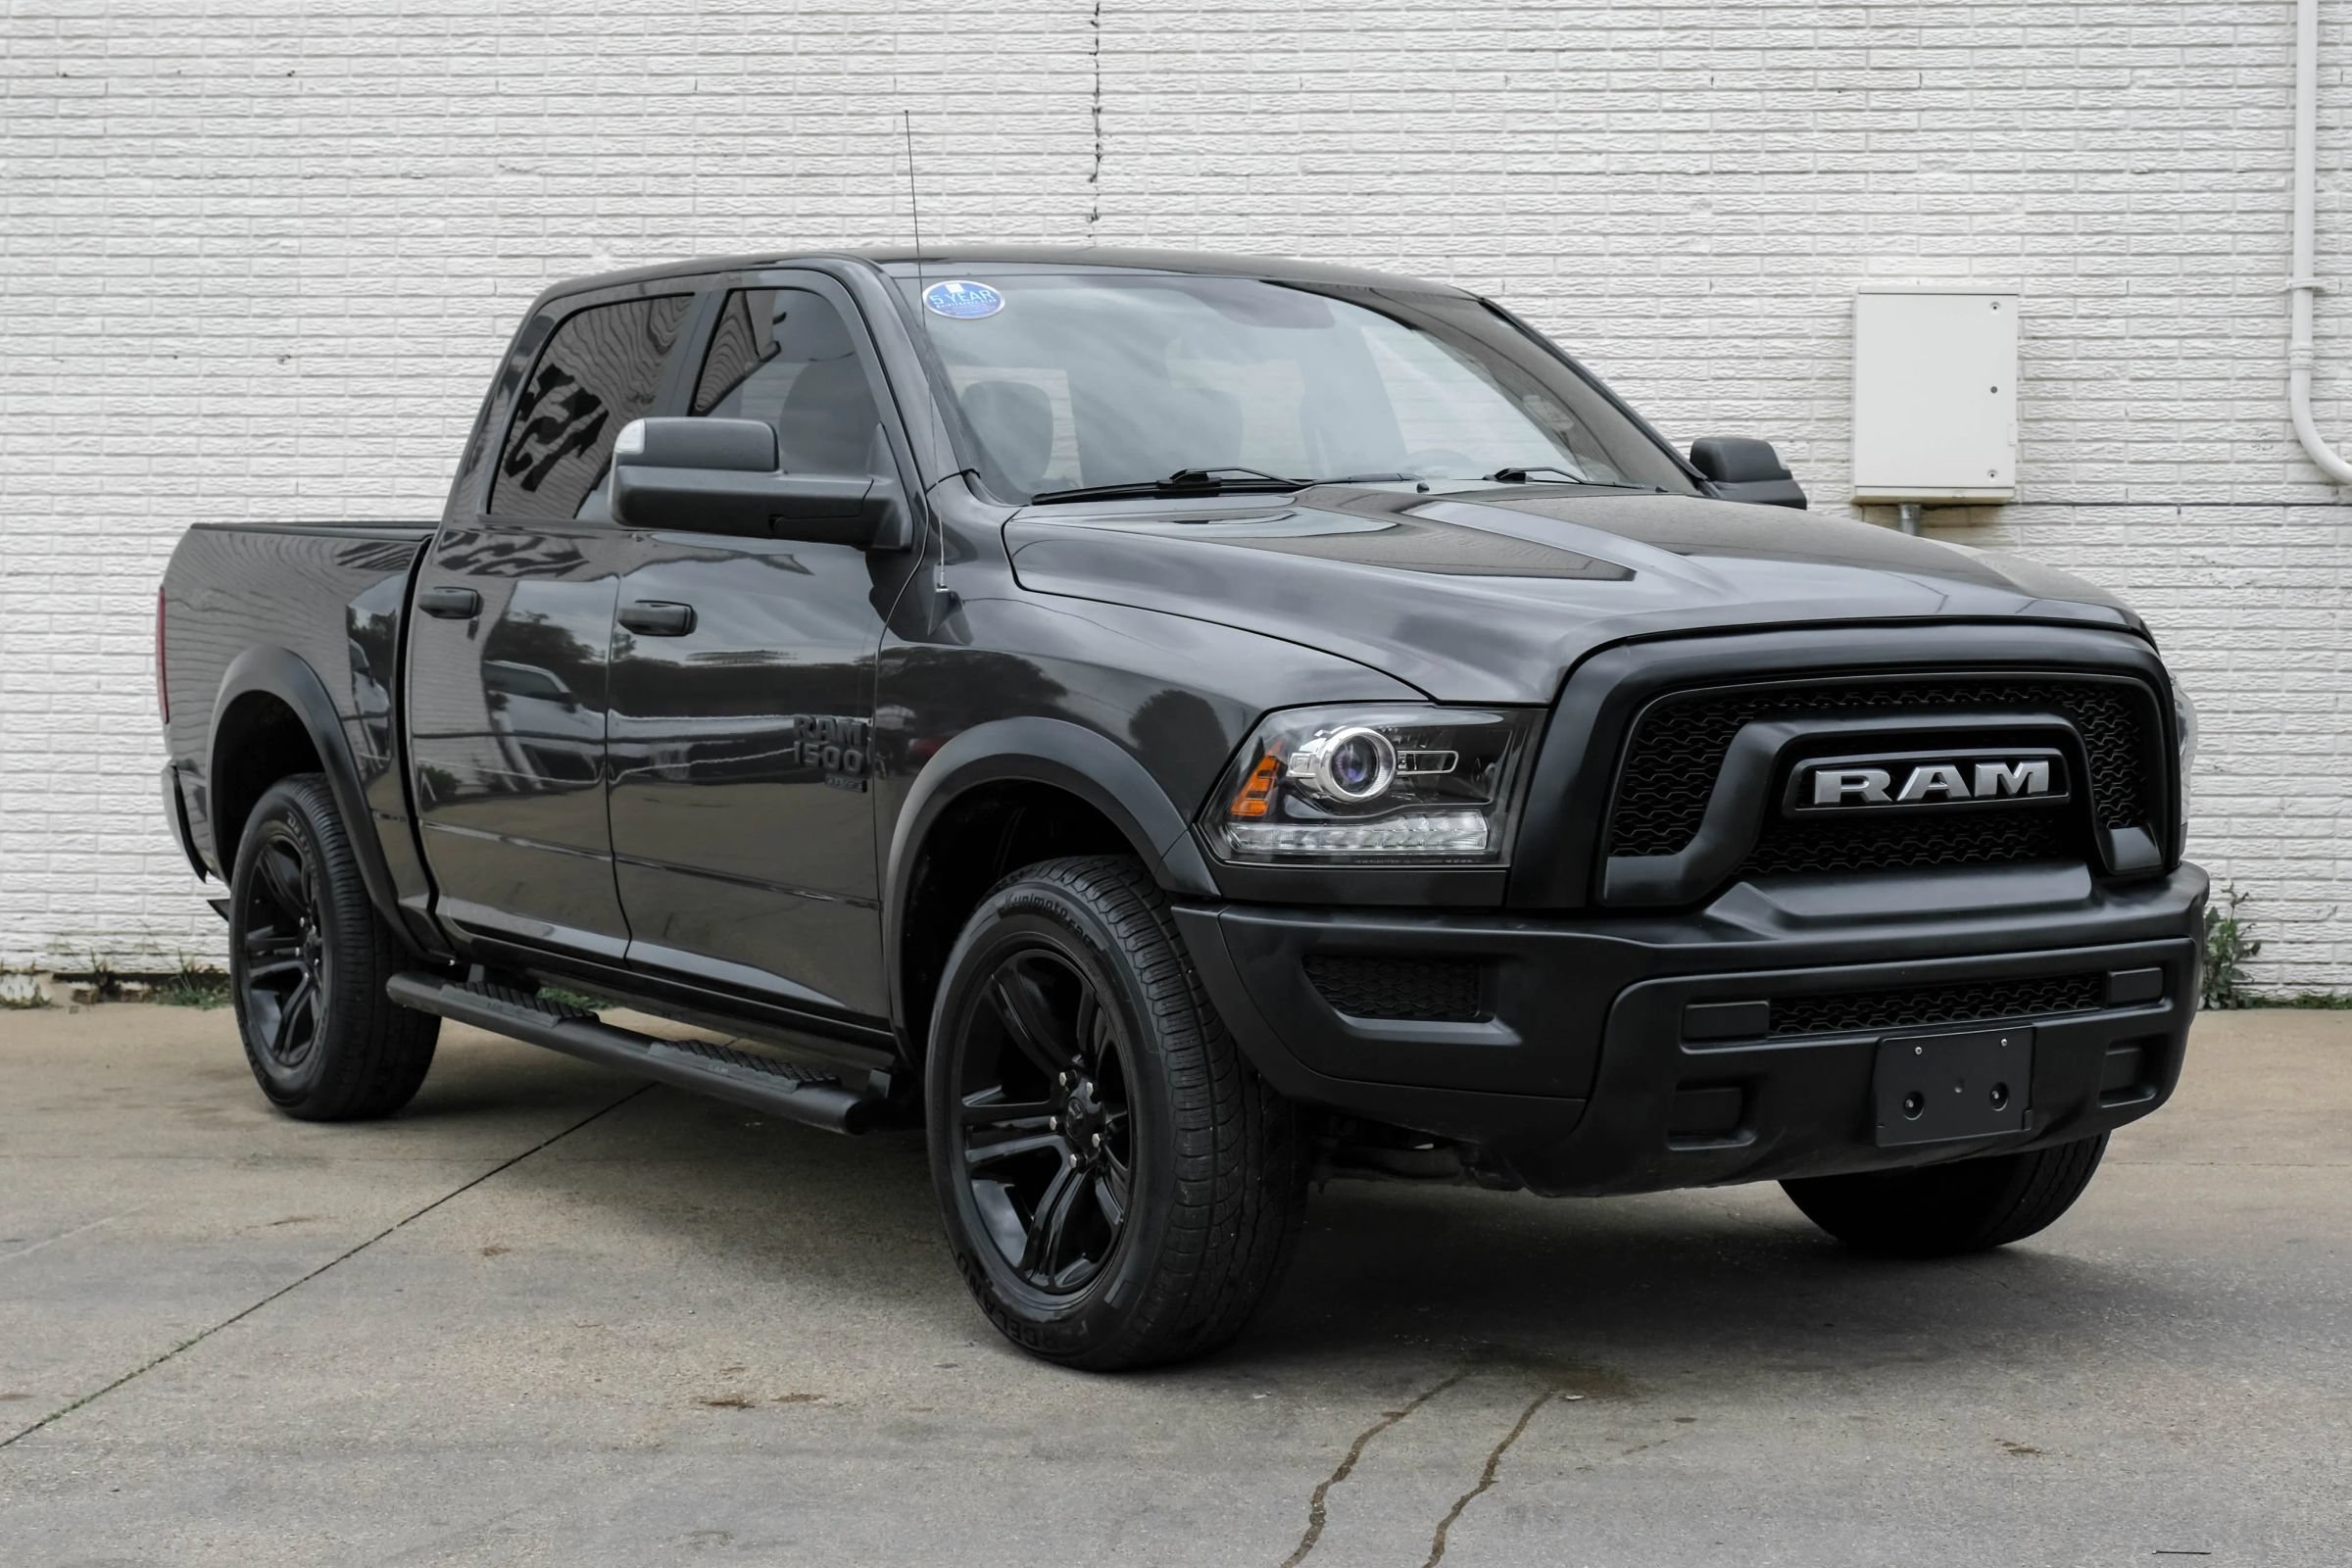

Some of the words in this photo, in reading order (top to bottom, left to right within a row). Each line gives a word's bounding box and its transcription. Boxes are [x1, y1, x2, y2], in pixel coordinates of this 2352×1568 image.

[928, 294, 945, 305] 5
[945, 289, 994, 303] YEAR
[794, 714, 865, 745] RAM
[794, 741, 863, 775] 1500
[1814, 760, 2049, 805] RAM
